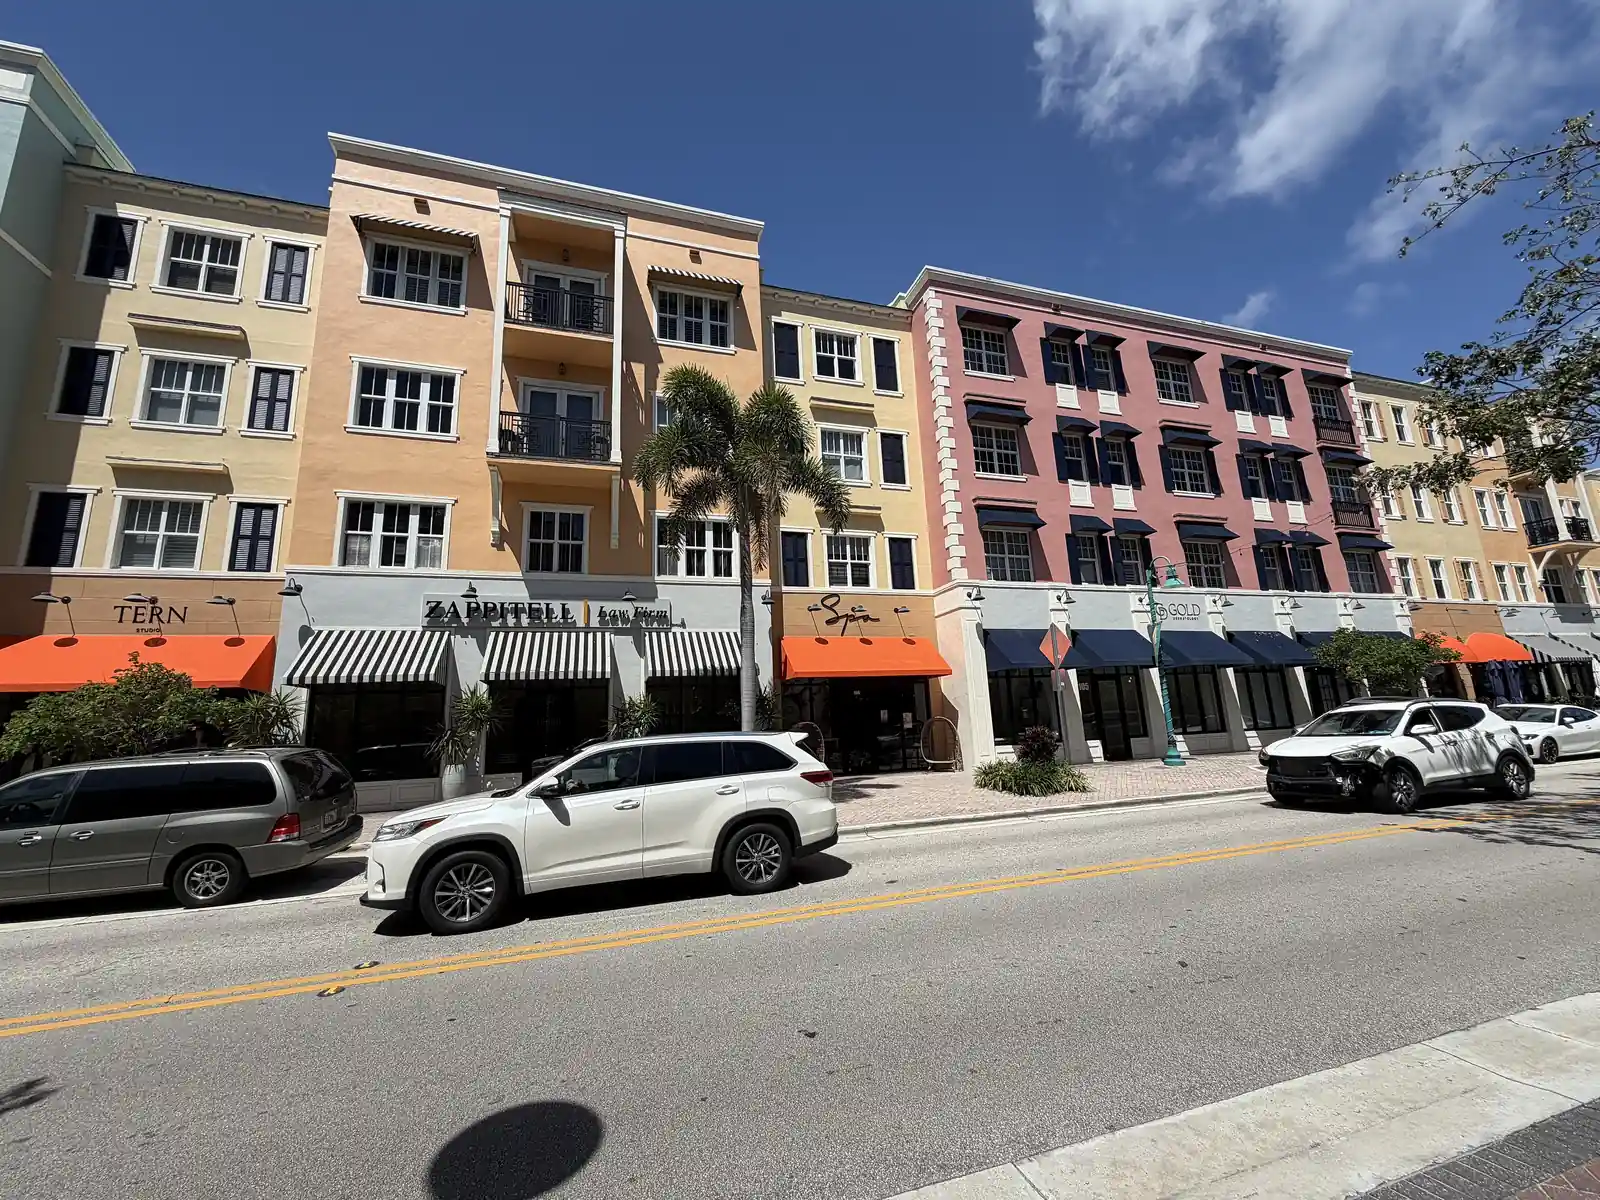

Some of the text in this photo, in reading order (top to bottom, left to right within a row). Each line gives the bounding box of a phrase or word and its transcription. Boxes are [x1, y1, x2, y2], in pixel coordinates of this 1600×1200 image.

[113, 605, 188, 624] TERN
[424, 600, 667, 619] ZAPPITELL Law Firm
[821, 593, 880, 637] Spa
[1168, 603, 1201, 616] GOLD
